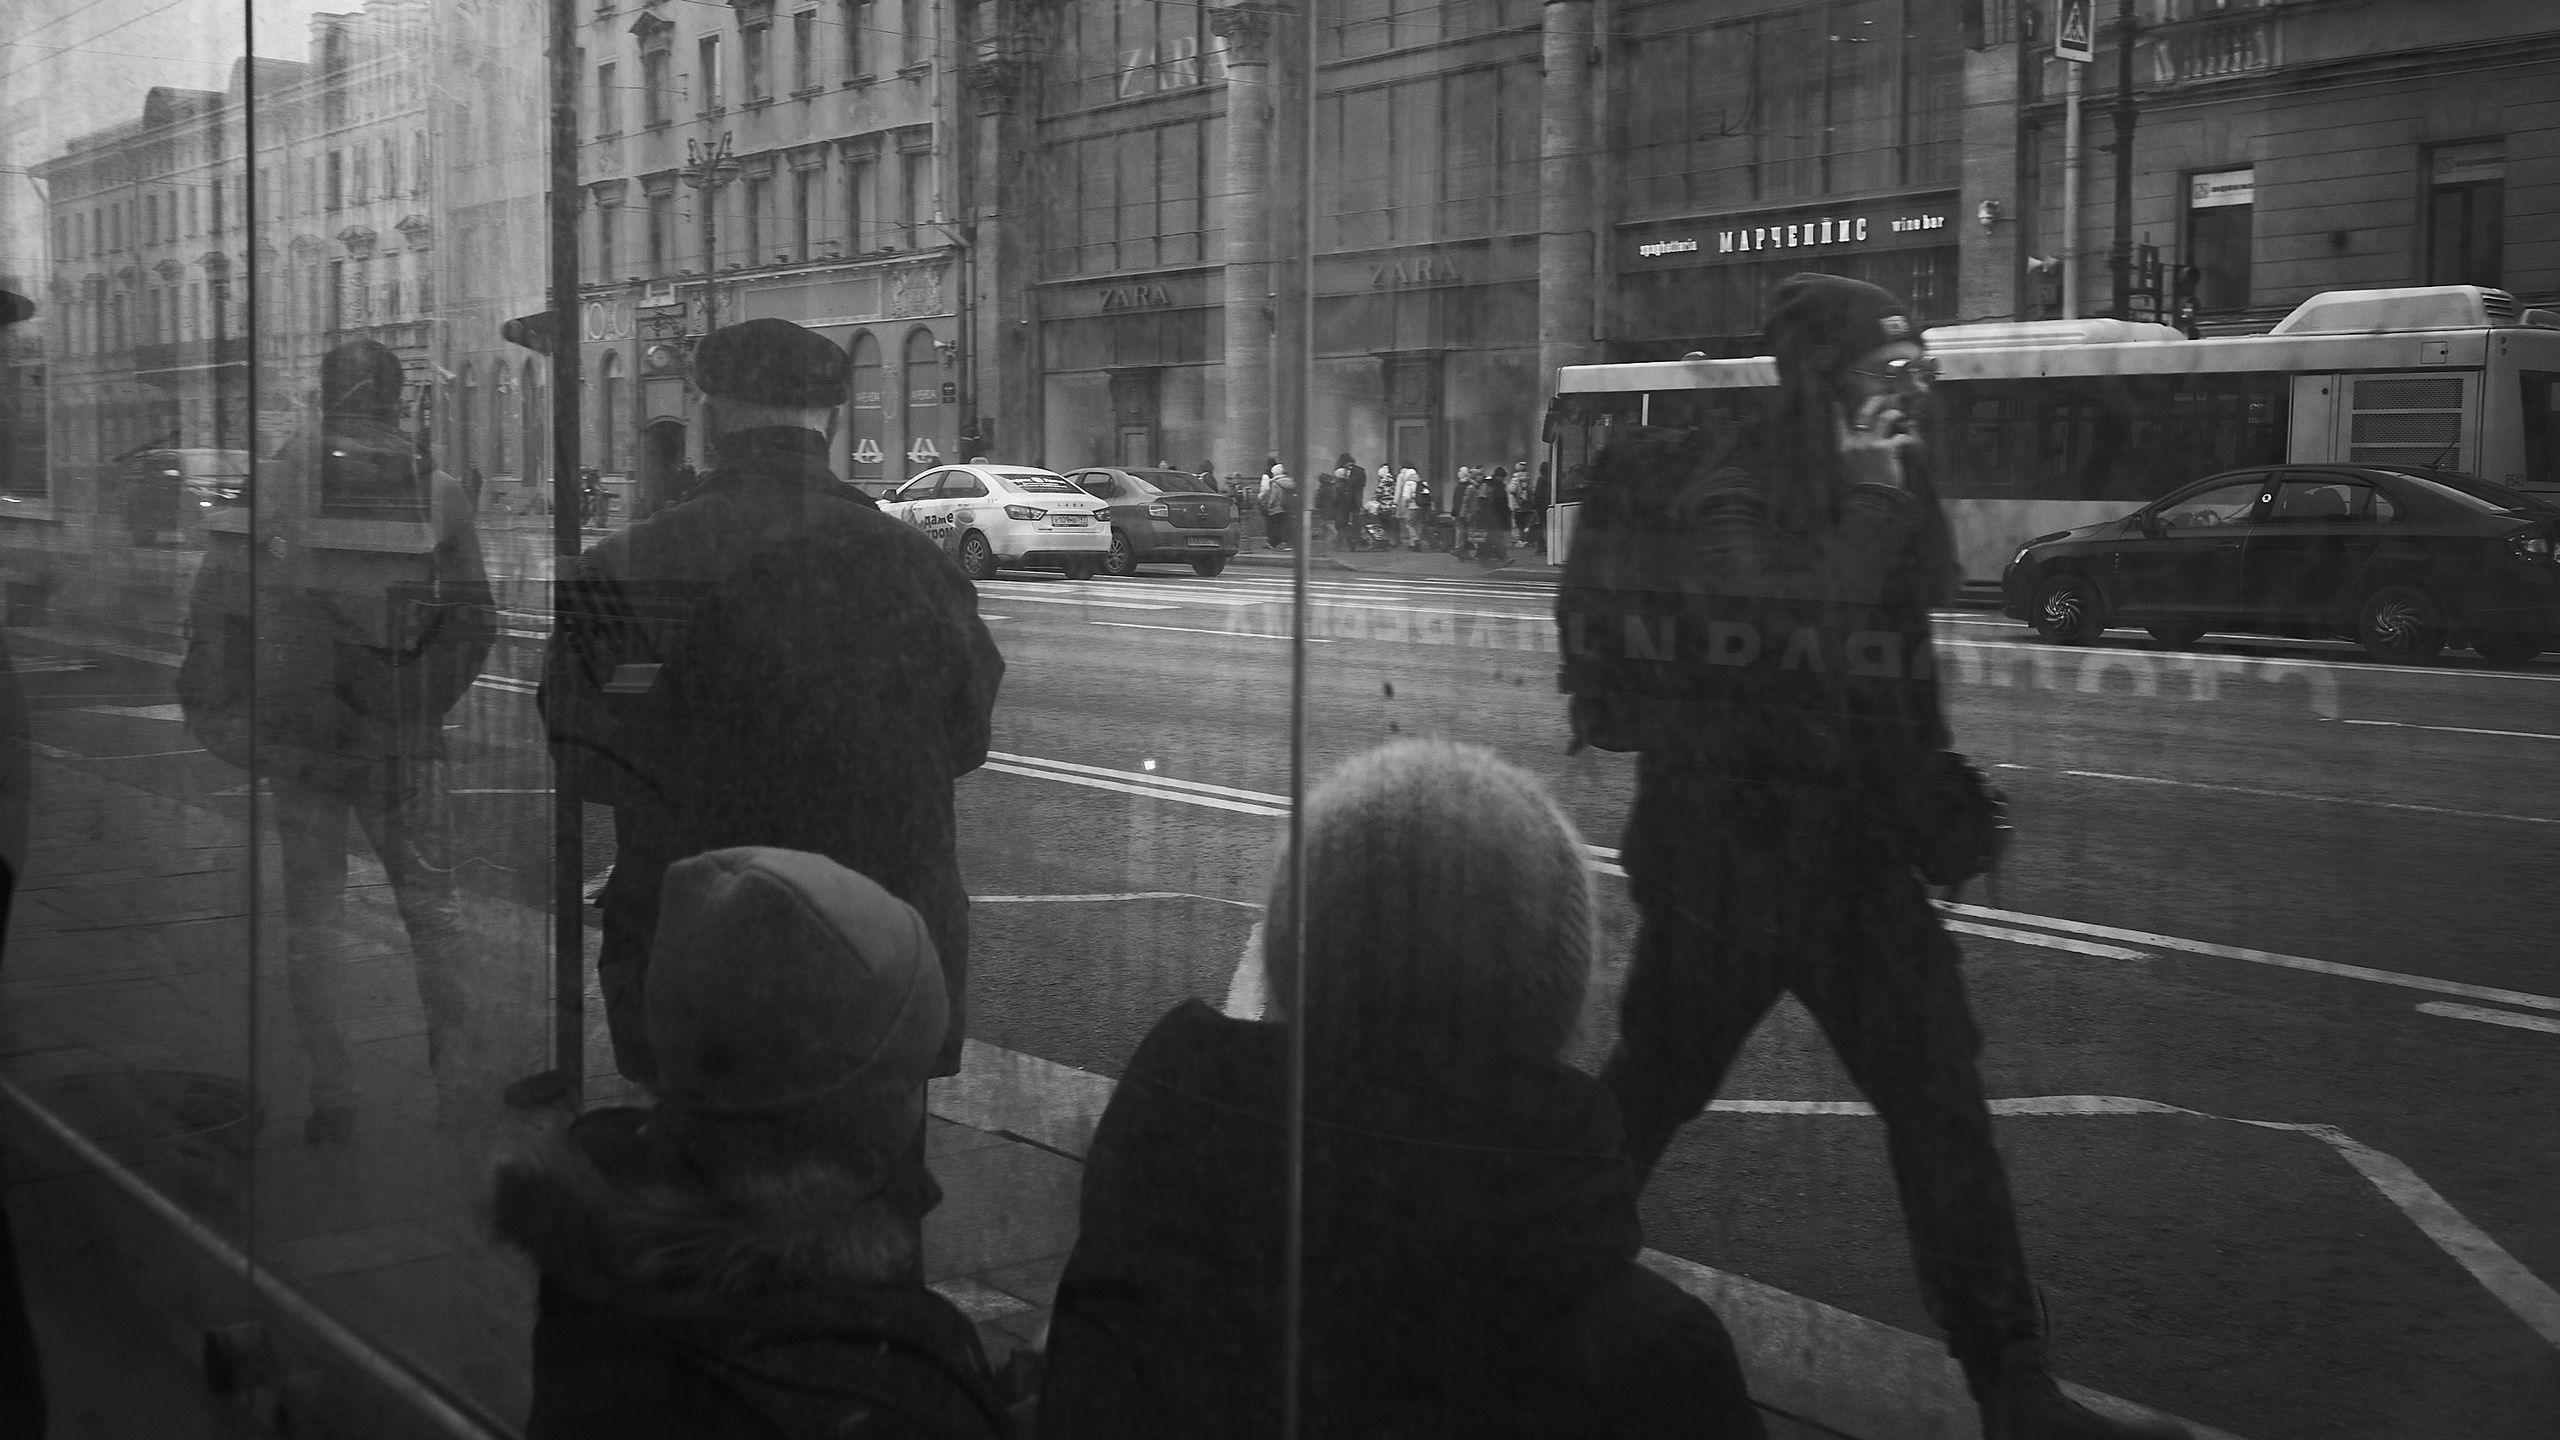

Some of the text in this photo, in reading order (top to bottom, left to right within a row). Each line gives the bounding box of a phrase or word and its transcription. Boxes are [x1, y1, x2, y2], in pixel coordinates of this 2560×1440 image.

[1922, 214, 1945, 229] bar
[1369, 256, 1461, 287] ZARA
[1100, 284, 1172, 311] ZARA
